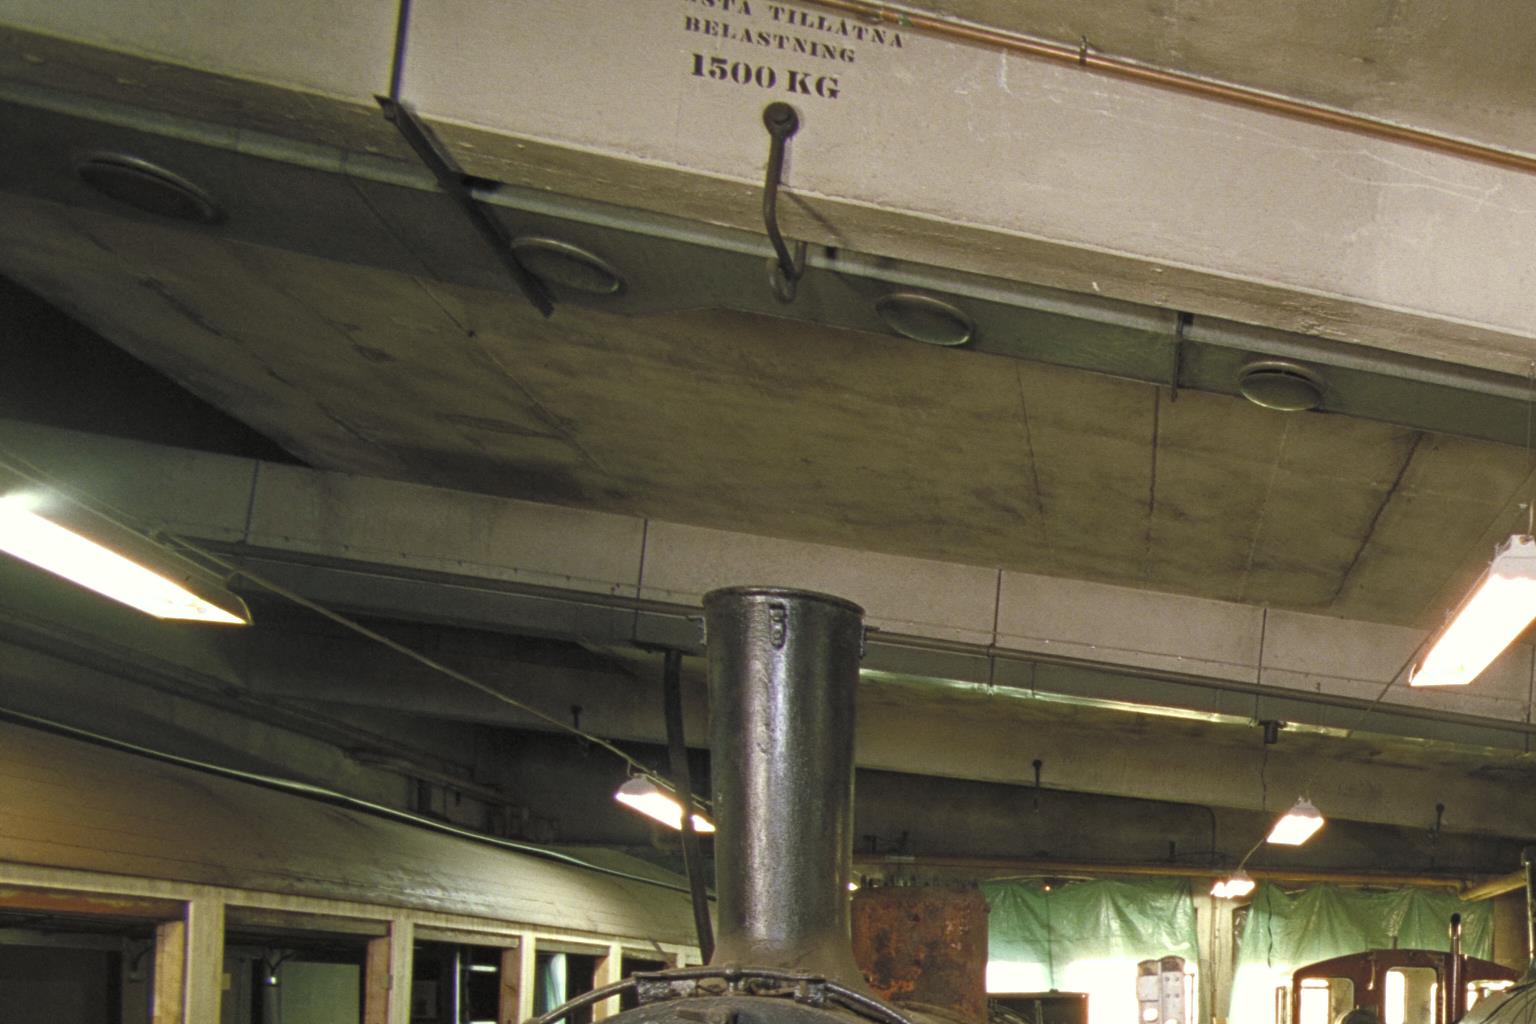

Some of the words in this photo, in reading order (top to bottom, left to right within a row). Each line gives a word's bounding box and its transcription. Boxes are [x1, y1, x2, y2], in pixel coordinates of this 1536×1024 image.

[685, 16, 855, 62] BELASTNING
[691, 53, 776, 89] 1500
[787, 70, 840, 99] KG
